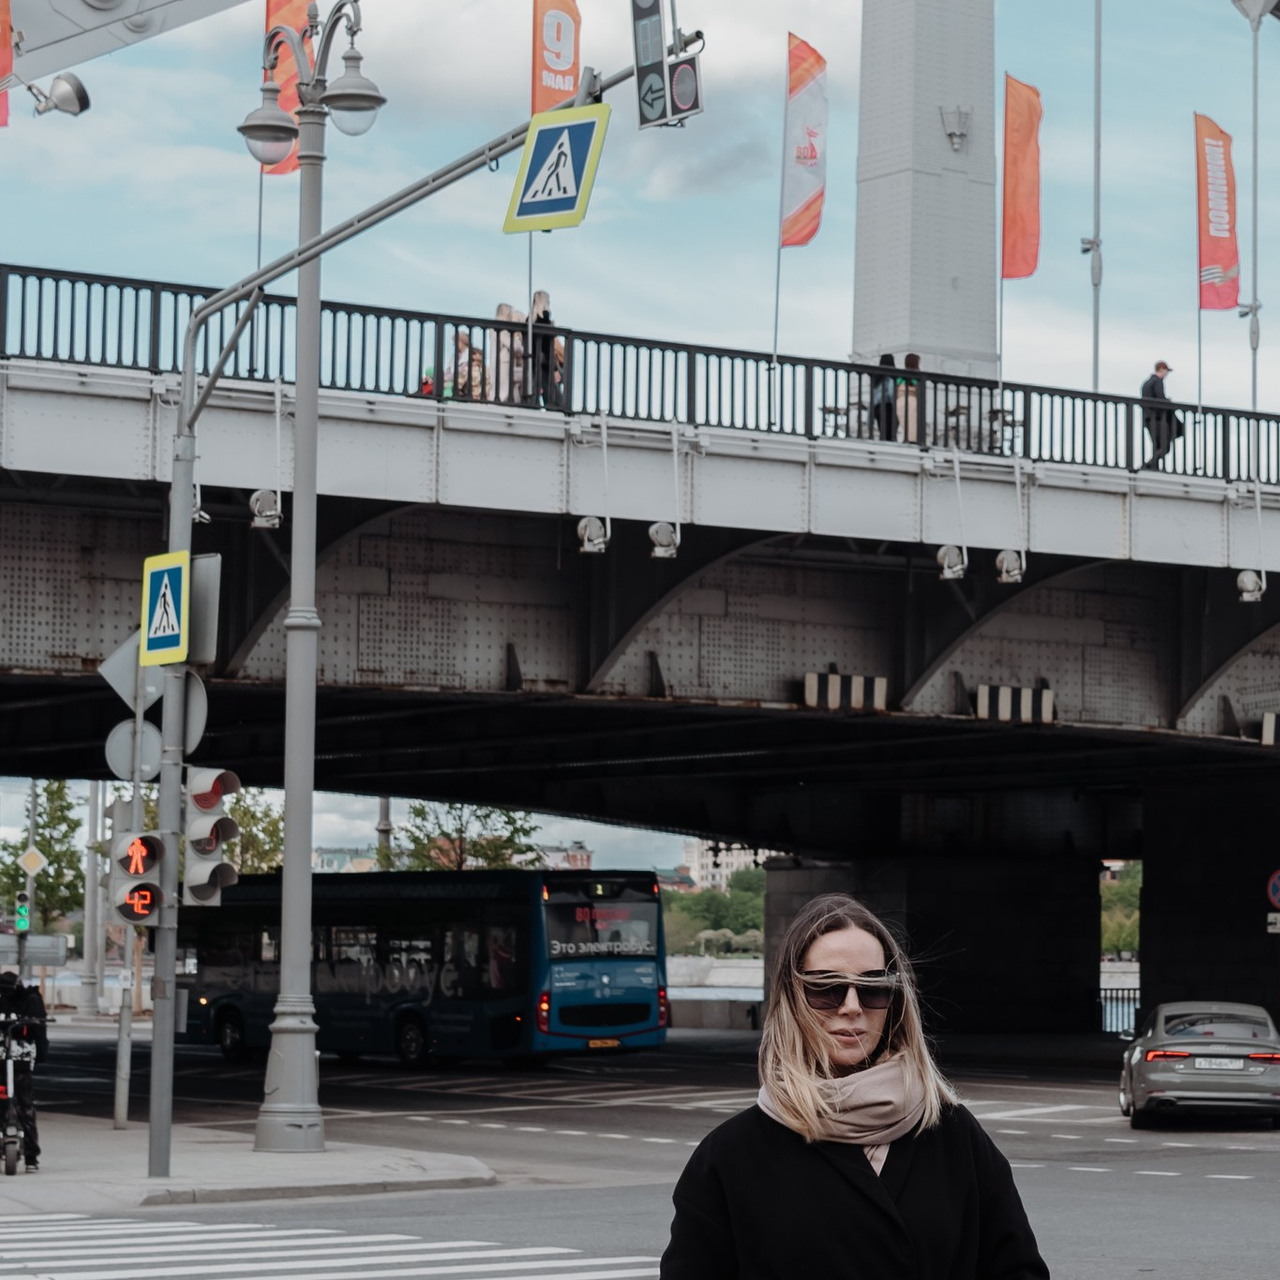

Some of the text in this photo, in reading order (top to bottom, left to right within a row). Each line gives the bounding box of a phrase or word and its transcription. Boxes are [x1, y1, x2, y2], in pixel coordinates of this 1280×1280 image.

[543, 9, 574, 71] 9
[542, 70, 574, 91] МАЯ
[1204, 138, 1230, 238] ПОМНИМ!
[125, 891, 151, 914] 42
[551, 940, 575, 954] Это
